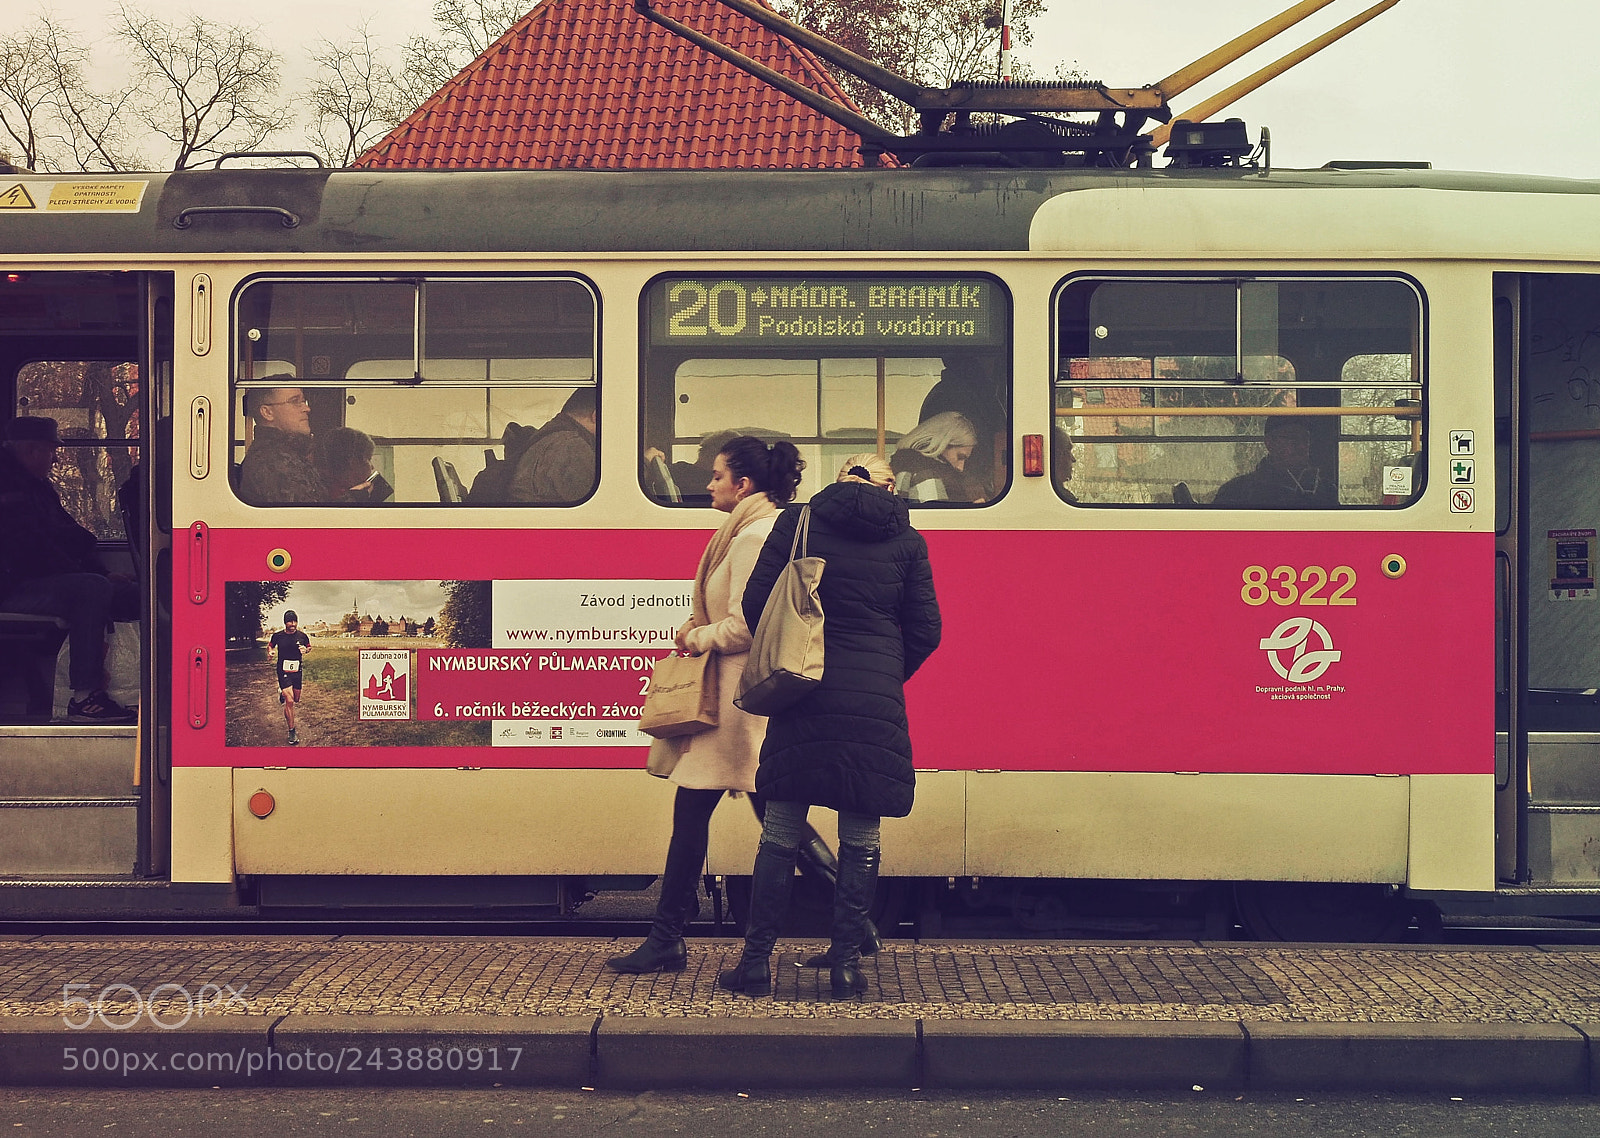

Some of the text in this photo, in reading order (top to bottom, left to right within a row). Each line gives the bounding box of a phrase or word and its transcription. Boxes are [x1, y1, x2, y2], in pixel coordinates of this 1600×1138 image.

[669, 280, 747, 336] 20
[759, 312, 976, 336] Podolská vodárna
[1240, 565, 1357, 606] 8322
[580, 594, 694, 610] Závod jednotli
[506, 626, 679, 644] www.nymburskypul
[372, 652, 393, 660] dubna
[394, 652, 408, 660] 2018
[429, 651, 656, 671] NYMBURSKÝ PŮLMARATON
[1255, 685, 1284, 693] Dopravní
[1285, 685, 1307, 693] podnik
[1296, 693, 1331, 701] společnost
[433, 702, 449, 718] 6.
[455, 701, 507, 717] ročník
[511, 701, 597, 720] běžeckých
